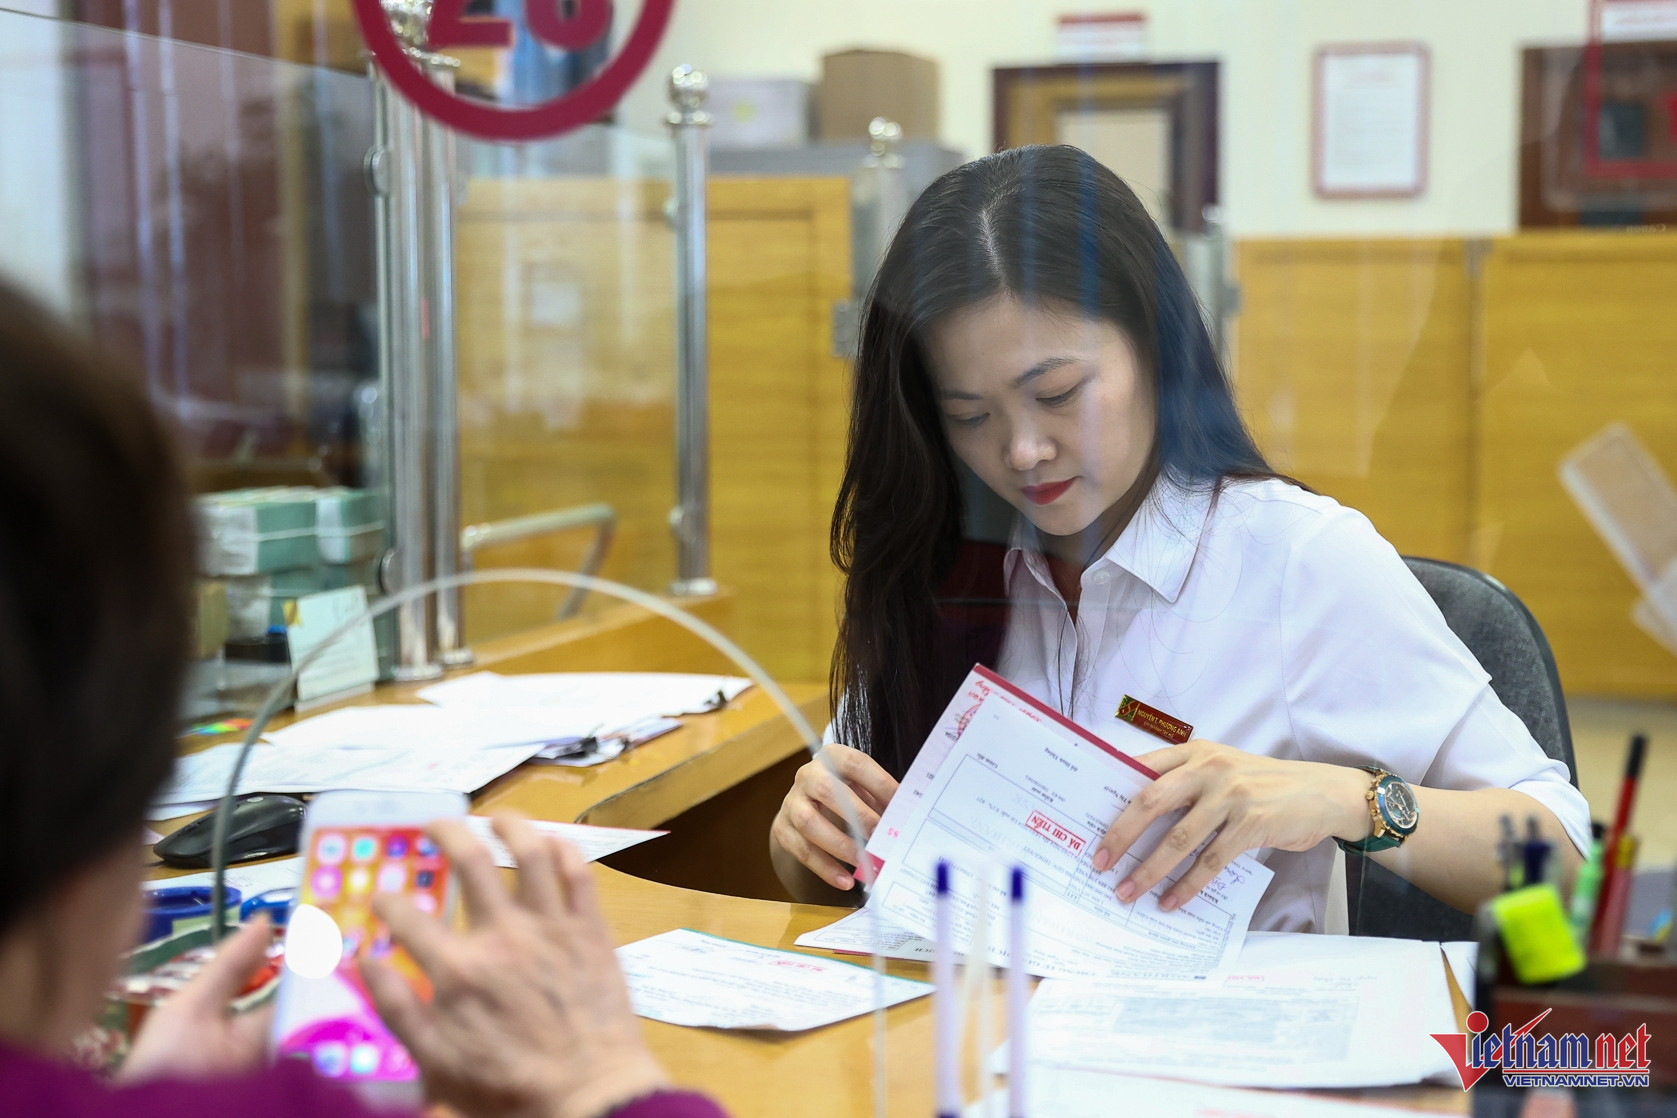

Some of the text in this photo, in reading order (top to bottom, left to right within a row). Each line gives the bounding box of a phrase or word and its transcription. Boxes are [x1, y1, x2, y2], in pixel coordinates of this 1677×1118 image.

[1176, 728, 1186, 737] ANH
[1031, 815, 1081, 850] ĐÃ CHI TIỀN
